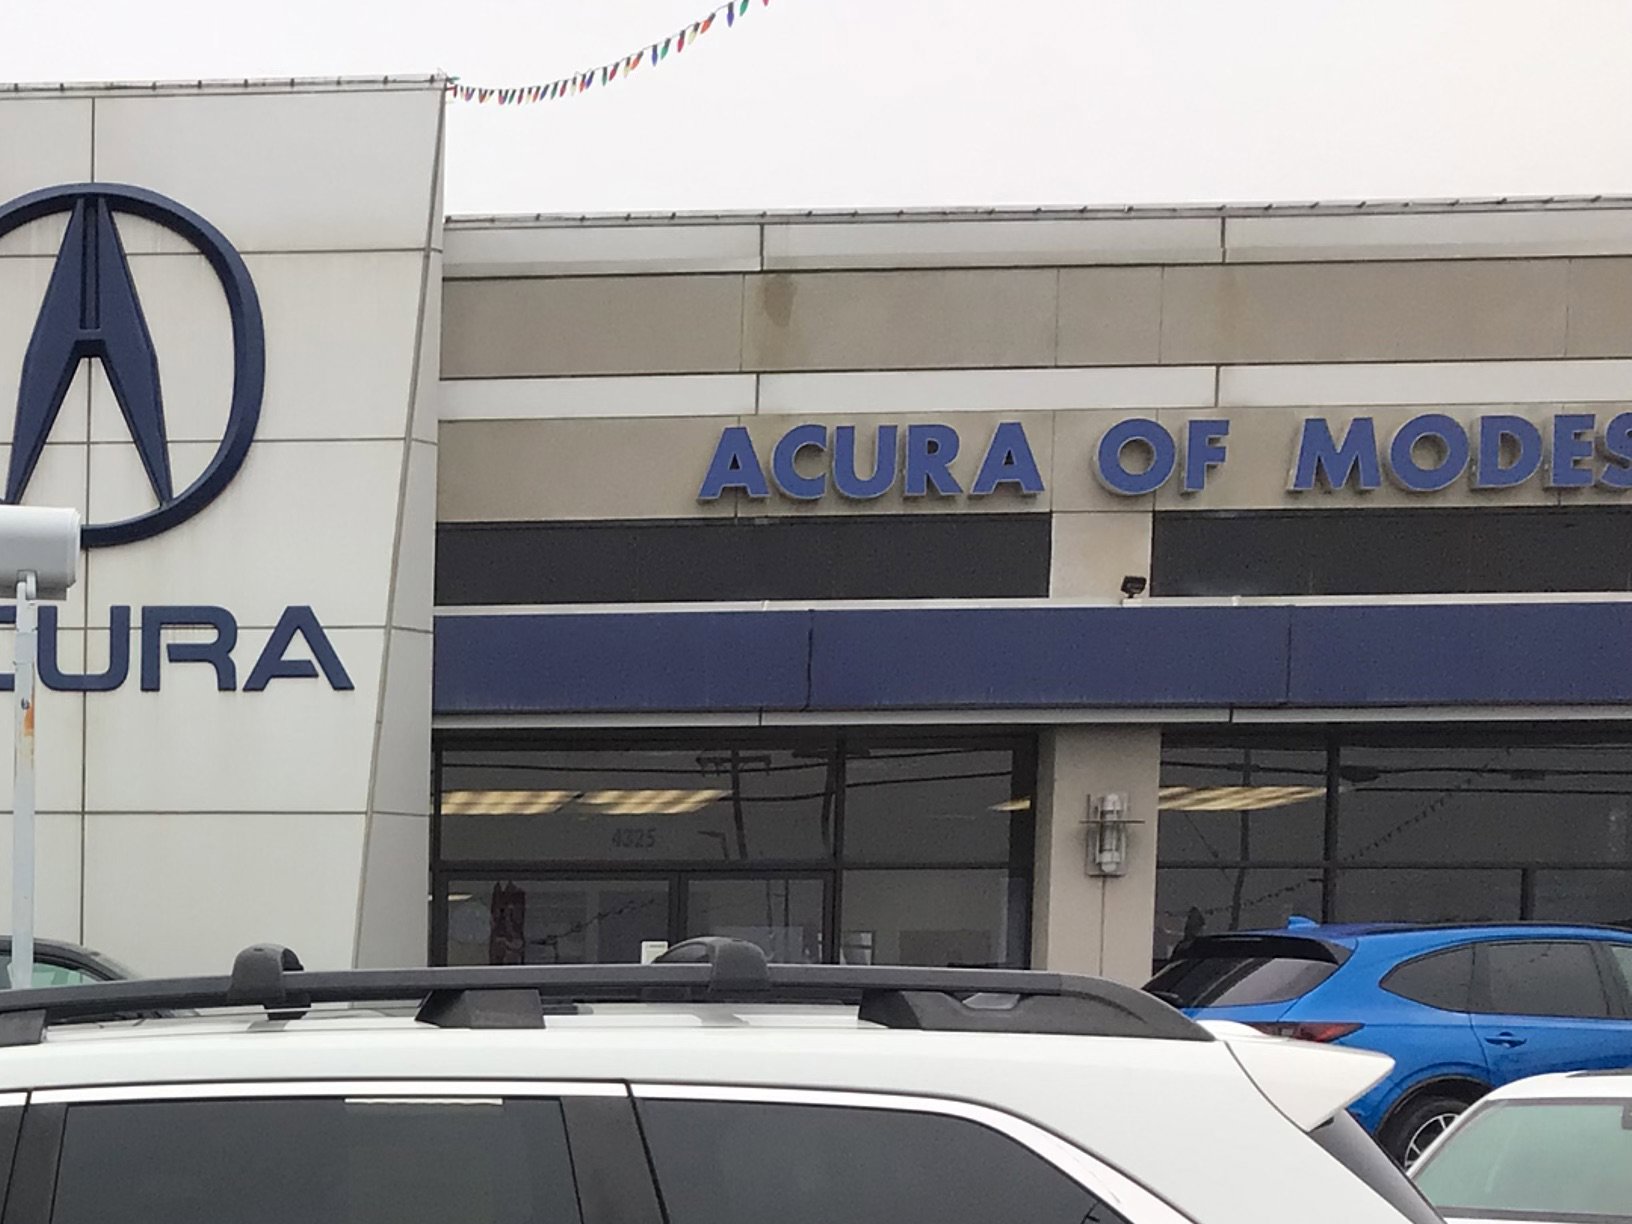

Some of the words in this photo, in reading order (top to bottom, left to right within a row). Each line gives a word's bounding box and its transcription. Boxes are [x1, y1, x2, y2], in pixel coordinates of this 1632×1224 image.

[697, 421, 1046, 500] ACURA
[1095, 416, 1230, 496] OF
[612, 827, 657, 849] 4325
